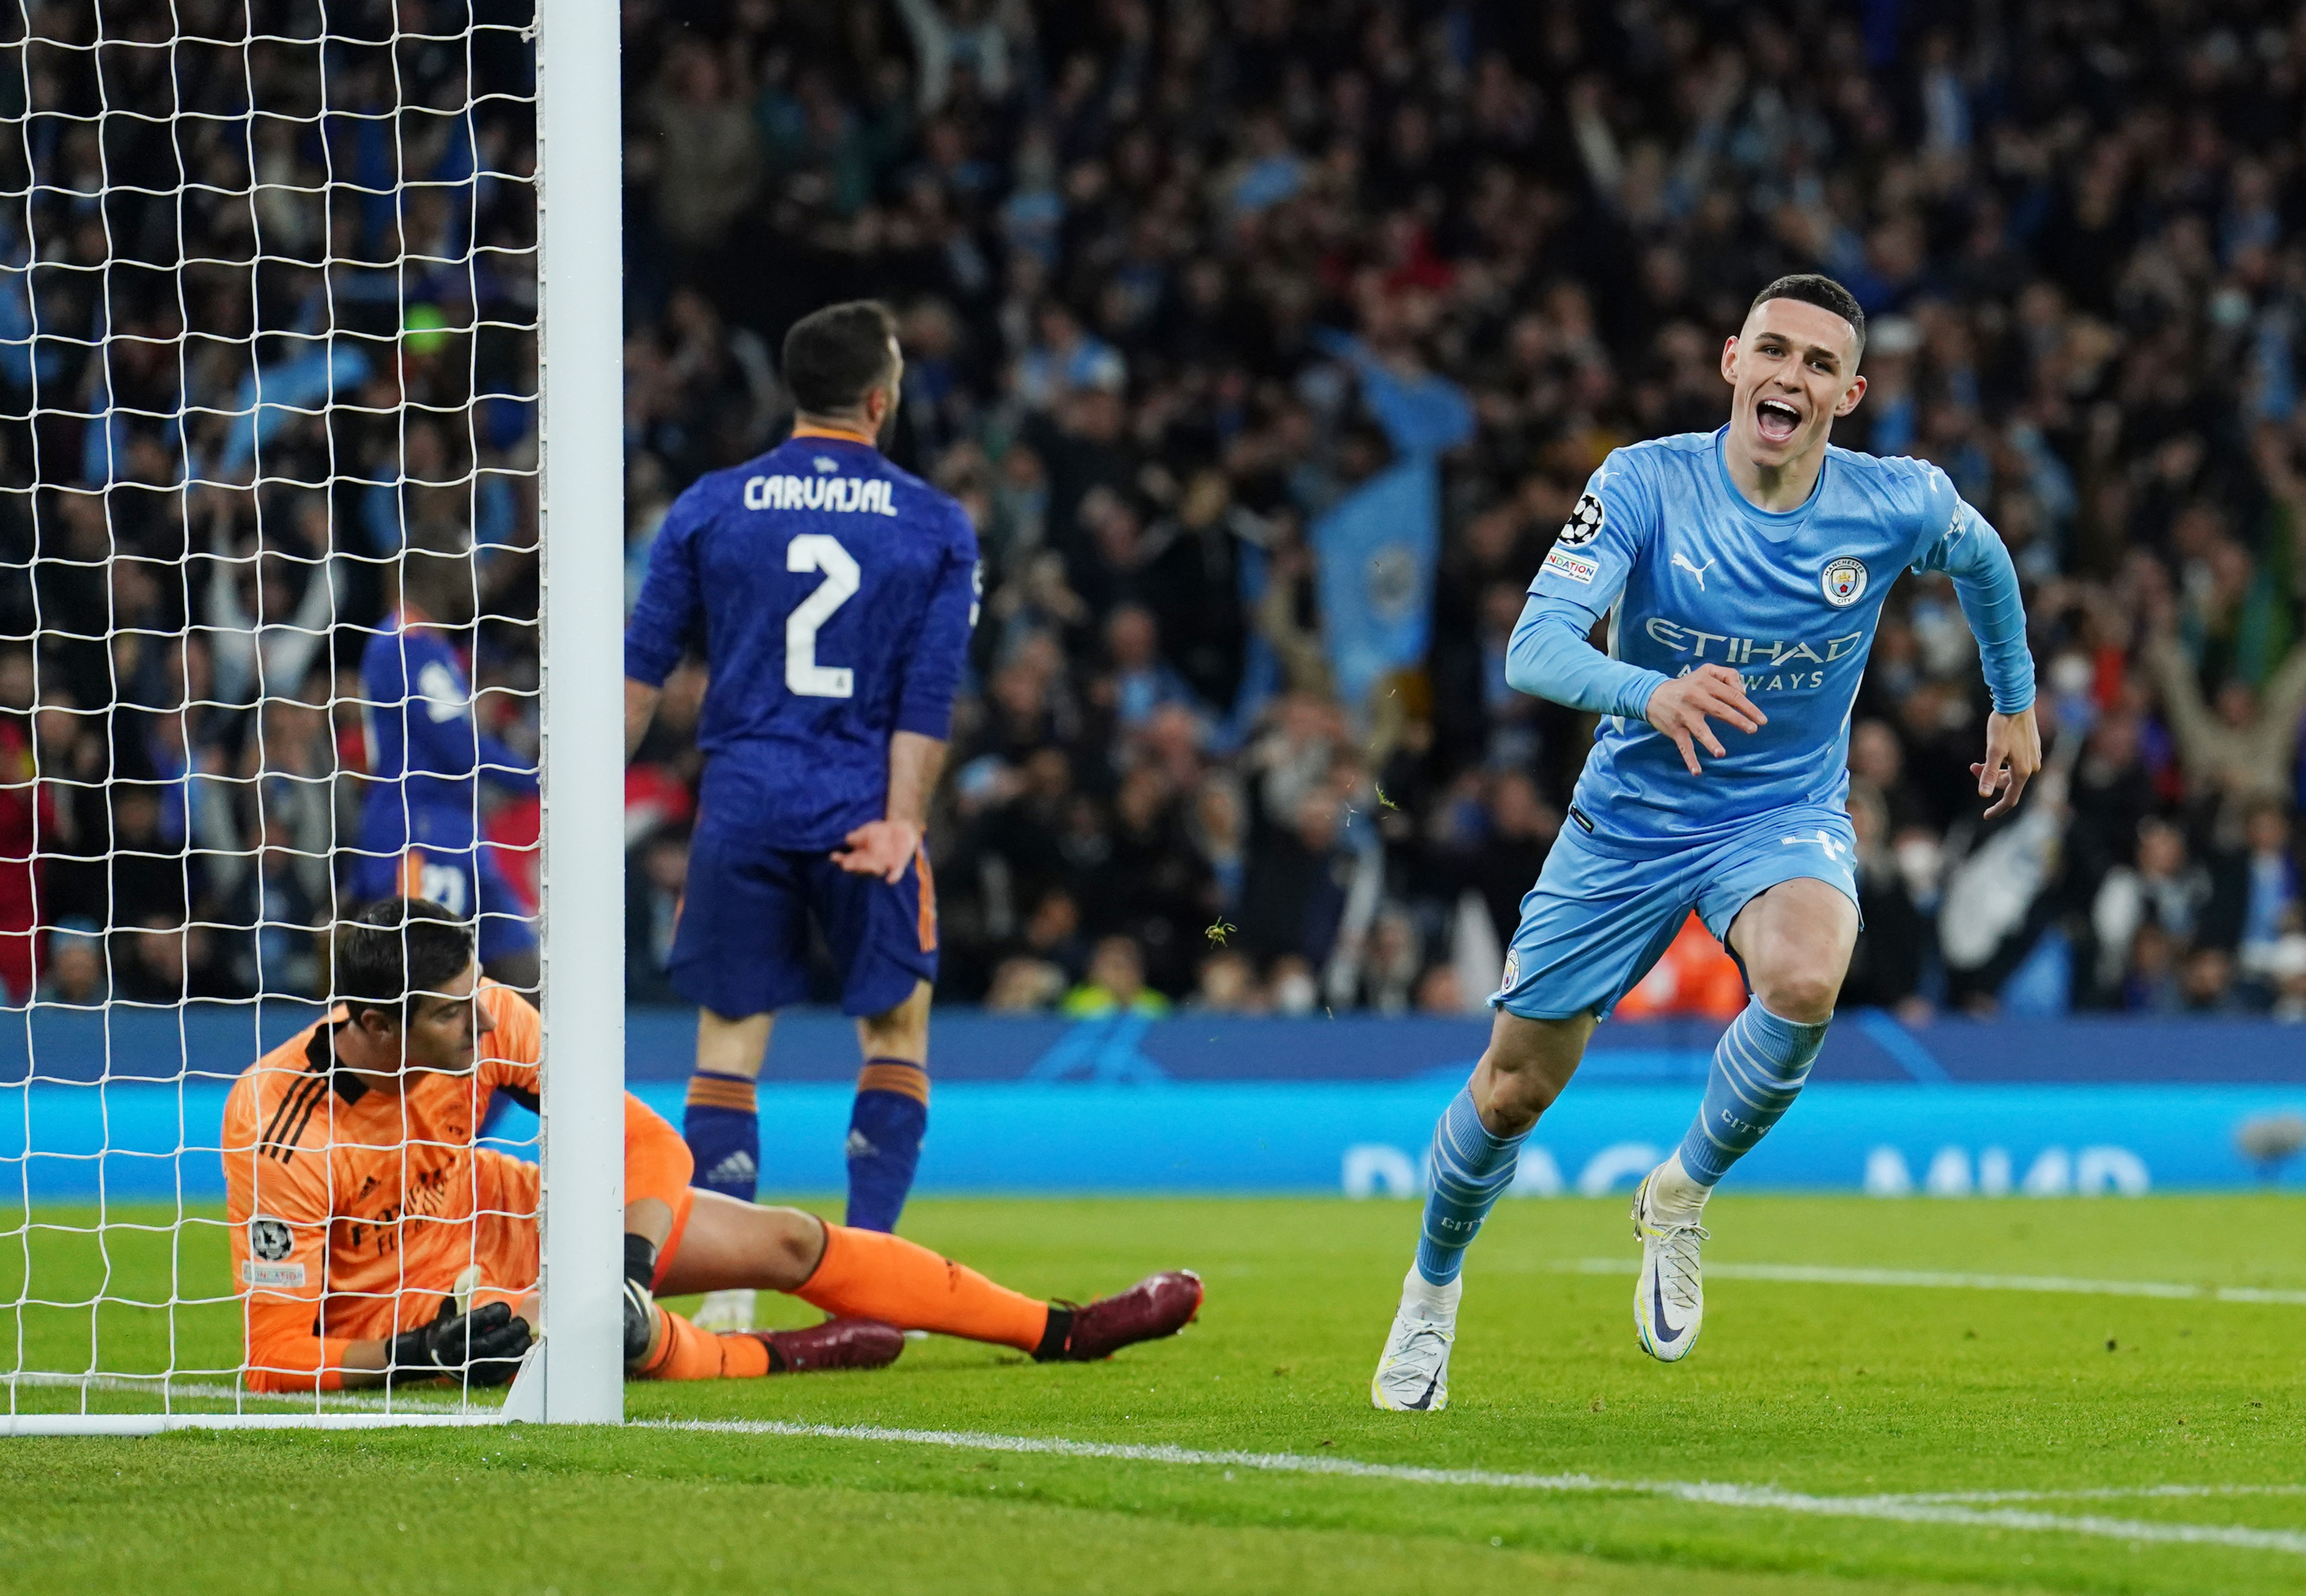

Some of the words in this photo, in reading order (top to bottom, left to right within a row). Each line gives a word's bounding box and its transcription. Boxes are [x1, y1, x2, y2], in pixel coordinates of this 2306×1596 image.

[743, 475, 898, 517] CARVAJAL
[1545, 555, 1594, 576] NDATION
[1825, 560, 1865, 576] MANCHESTER
[786, 533, 861, 698] 2
[1646, 617, 1862, 666] ETIHAD
[1676, 664, 1824, 691] AWAYS
[1721, 1108, 1772, 1134] CITY
[1442, 1211, 1489, 1232] CITY
